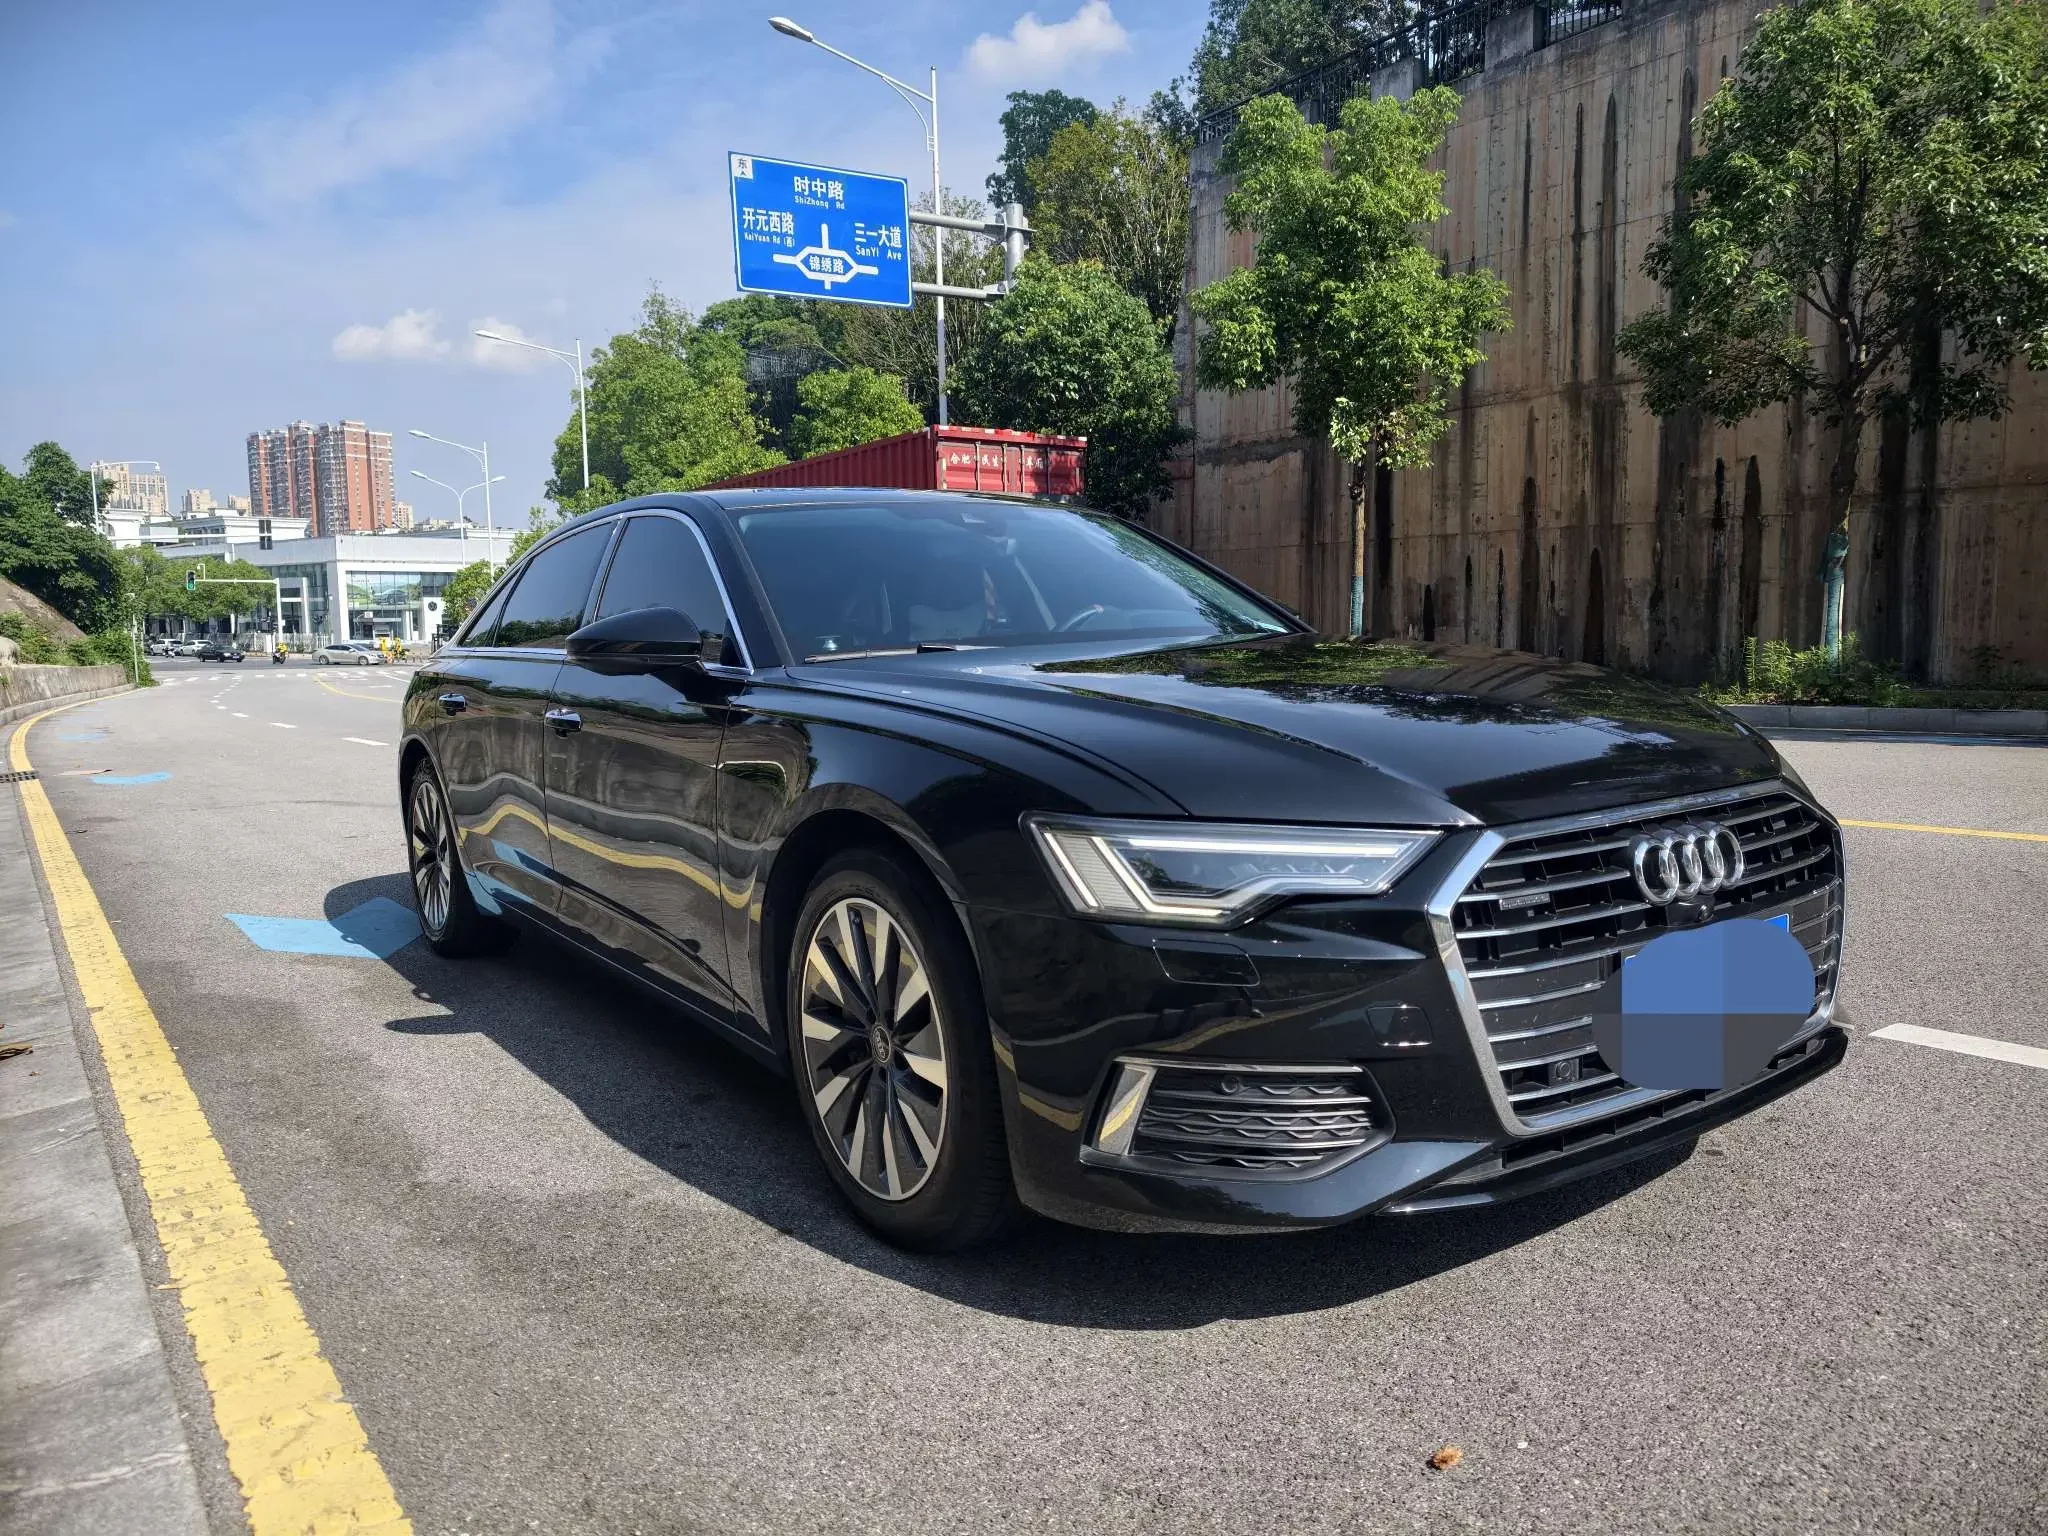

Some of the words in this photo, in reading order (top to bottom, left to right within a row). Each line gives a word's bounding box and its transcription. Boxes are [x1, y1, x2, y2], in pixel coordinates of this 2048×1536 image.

[737, 158, 747, 169] 东
[793, 176, 845, 201] 时中路
[794, 196, 829, 209] ShiZhong
[836, 201, 845, 209] Rd
[742, 207, 794, 235] 开元西路
[744, 232, 770, 243] KaiYuan
[772, 235, 781, 245] Rd
[854, 222, 902, 248] 三一大道
[887, 250, 902, 261] Ave
[809, 256, 844, 273] 锦绣路
